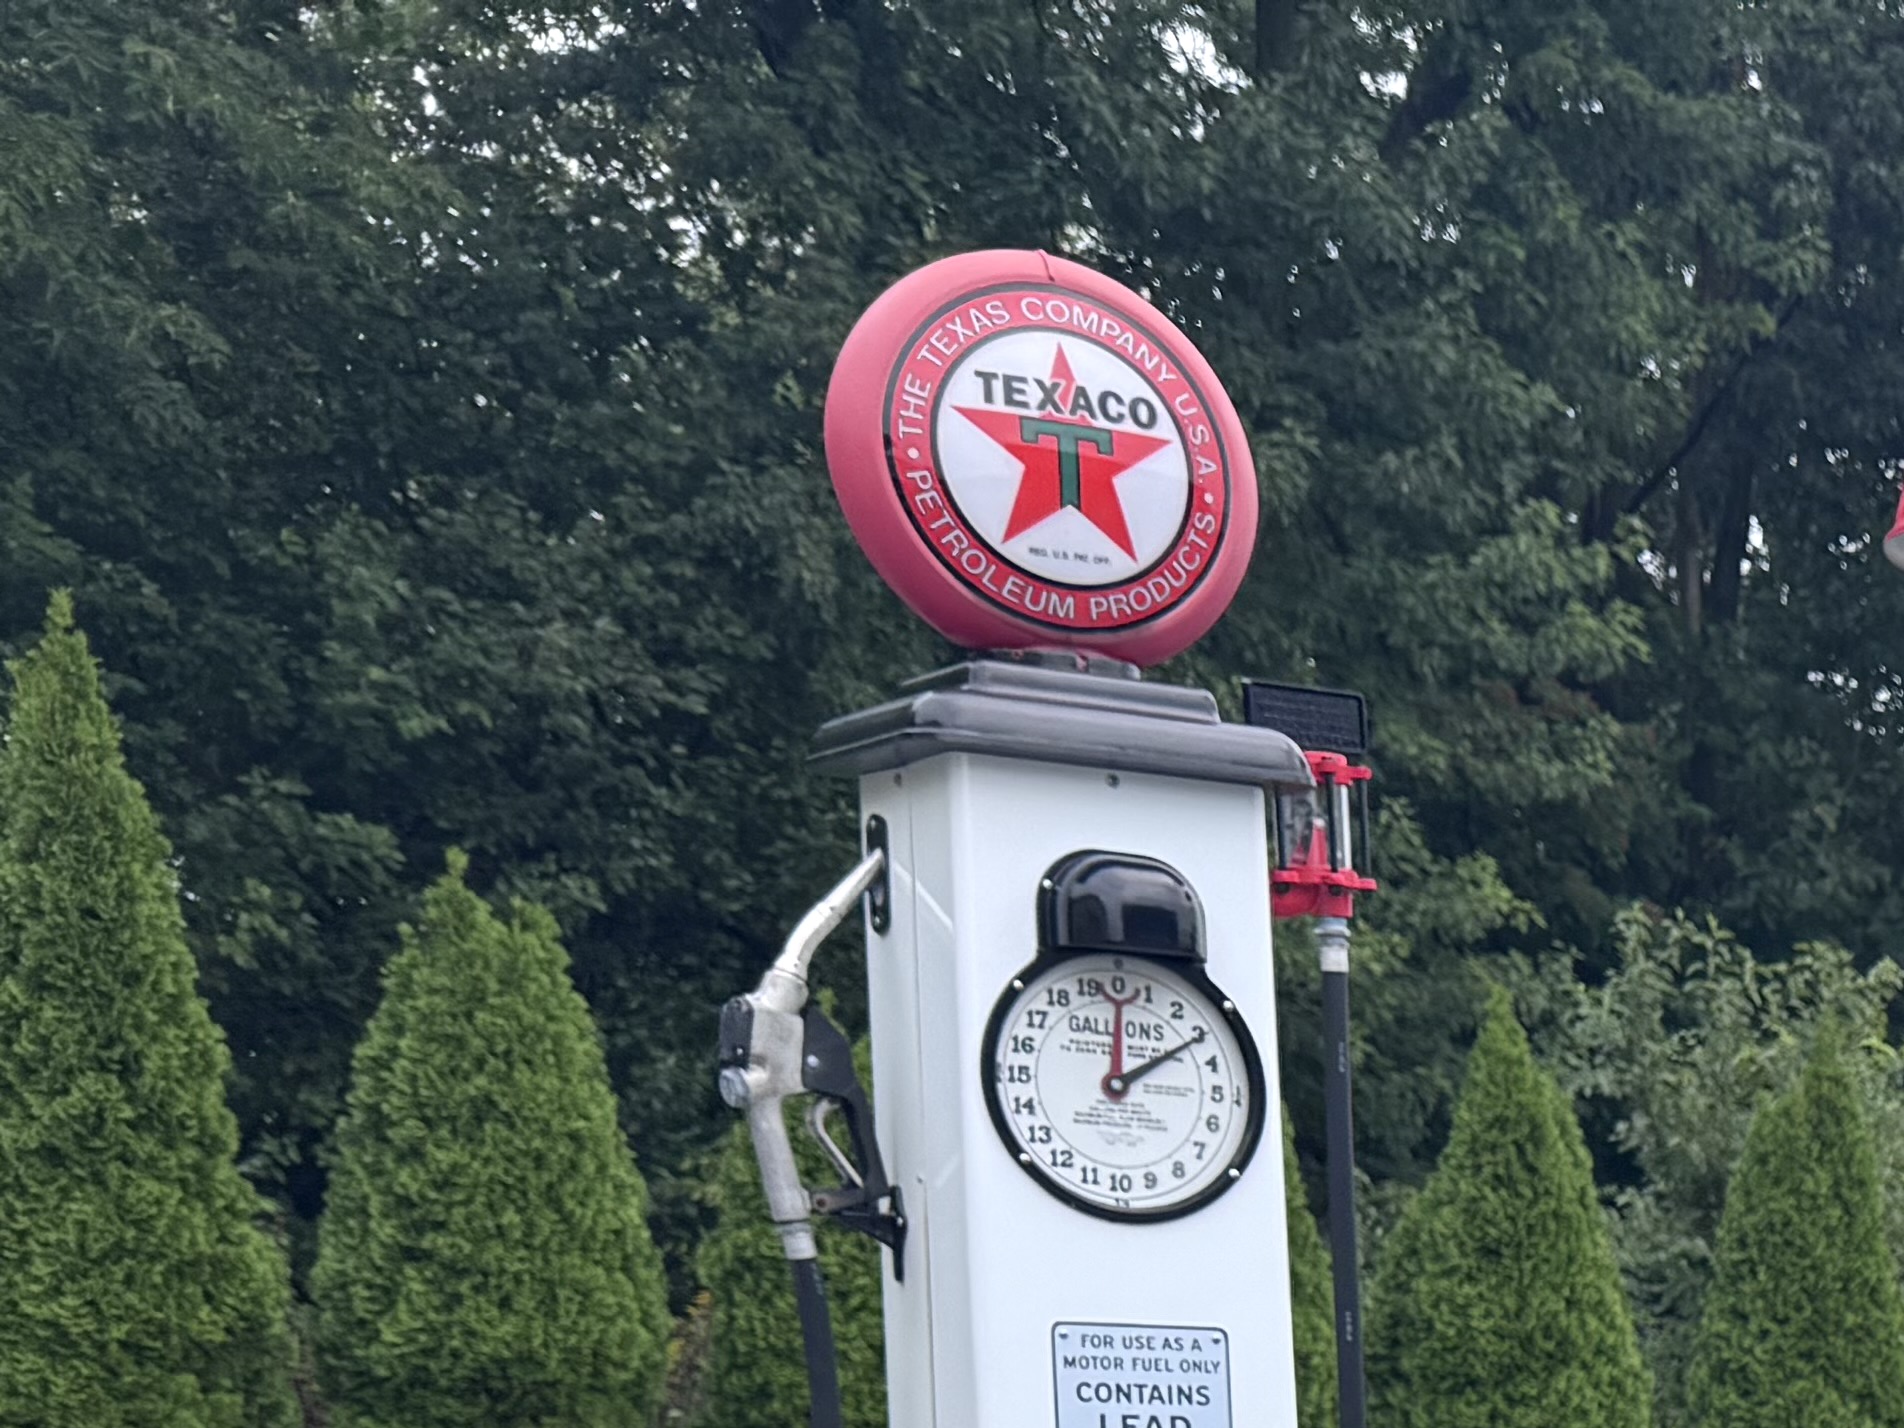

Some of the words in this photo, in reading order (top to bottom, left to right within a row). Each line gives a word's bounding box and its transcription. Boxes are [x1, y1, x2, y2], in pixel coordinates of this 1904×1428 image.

[898, 373, 931, 441] THE
[917, 300, 1010, 368] TEXAS
[1020, 297, 1176, 382] COMPANY
[1175, 392, 1217, 485] U.S.A.
[974, 369, 1157, 431] TEXACO
[906, 468, 1075, 619] PETROLEUM
[1090, 512, 1216, 622] PRODUCTS
[1077, 977, 1099, 996] 19
[1112, 976, 1125, 994] 0
[1046, 987, 1070, 1007] 18
[1143, 986, 1153, 1004] 1
[1026, 1009, 1049, 1029] 17
[1170, 1001, 1185, 1020] 2
[1011, 1034, 1034, 1054] 16
[1205, 1055, 1218, 1073] 4
[1007, 1065, 1032, 1084] 15
[1210, 1085, 1224, 1103] 5
[1013, 1096, 1036, 1116] 14
[1206, 1115, 1220, 1133] 6
[1028, 1125, 1051, 1144] 13
[1050, 1149, 1074, 1168] 12
[1192, 1141, 1206, 1160] 7
[1080, 1167, 1100, 1185] 11
[1171, 1161, 1186, 1179] 8
[1109, 1174, 1132, 1193] 10
[1143, 1171, 1158, 1189] 9
[1081, 1333, 1115, 1349] FOR
[1122, 1335, 1156, 1350] USE
[1162, 1337, 1184, 1351] AS
[1191, 1338, 1203, 1352] A
[1063, 1355, 1124, 1371] MOTOR
[1132, 1357, 1174, 1373] FUEL
[1179, 1359, 1221, 1374] ONLY
[1076, 1382, 1211, 1406] CONTAINS
